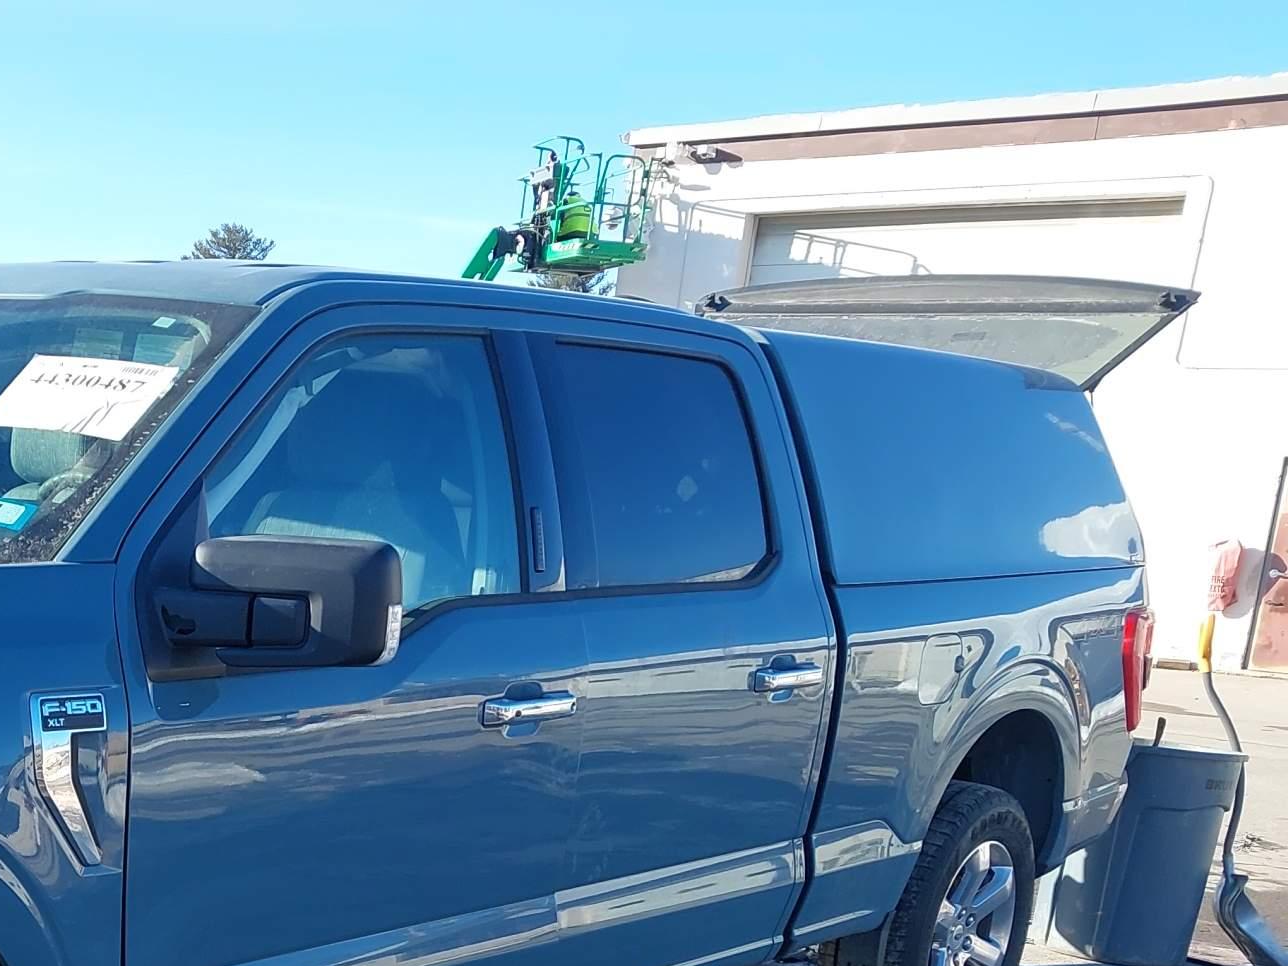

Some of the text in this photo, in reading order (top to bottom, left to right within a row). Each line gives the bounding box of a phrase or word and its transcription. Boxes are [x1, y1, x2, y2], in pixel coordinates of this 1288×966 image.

[30, 372, 148, 393] 44300487
[42, 699, 102, 717] F-150
[48, 718, 65, 728] XLT
